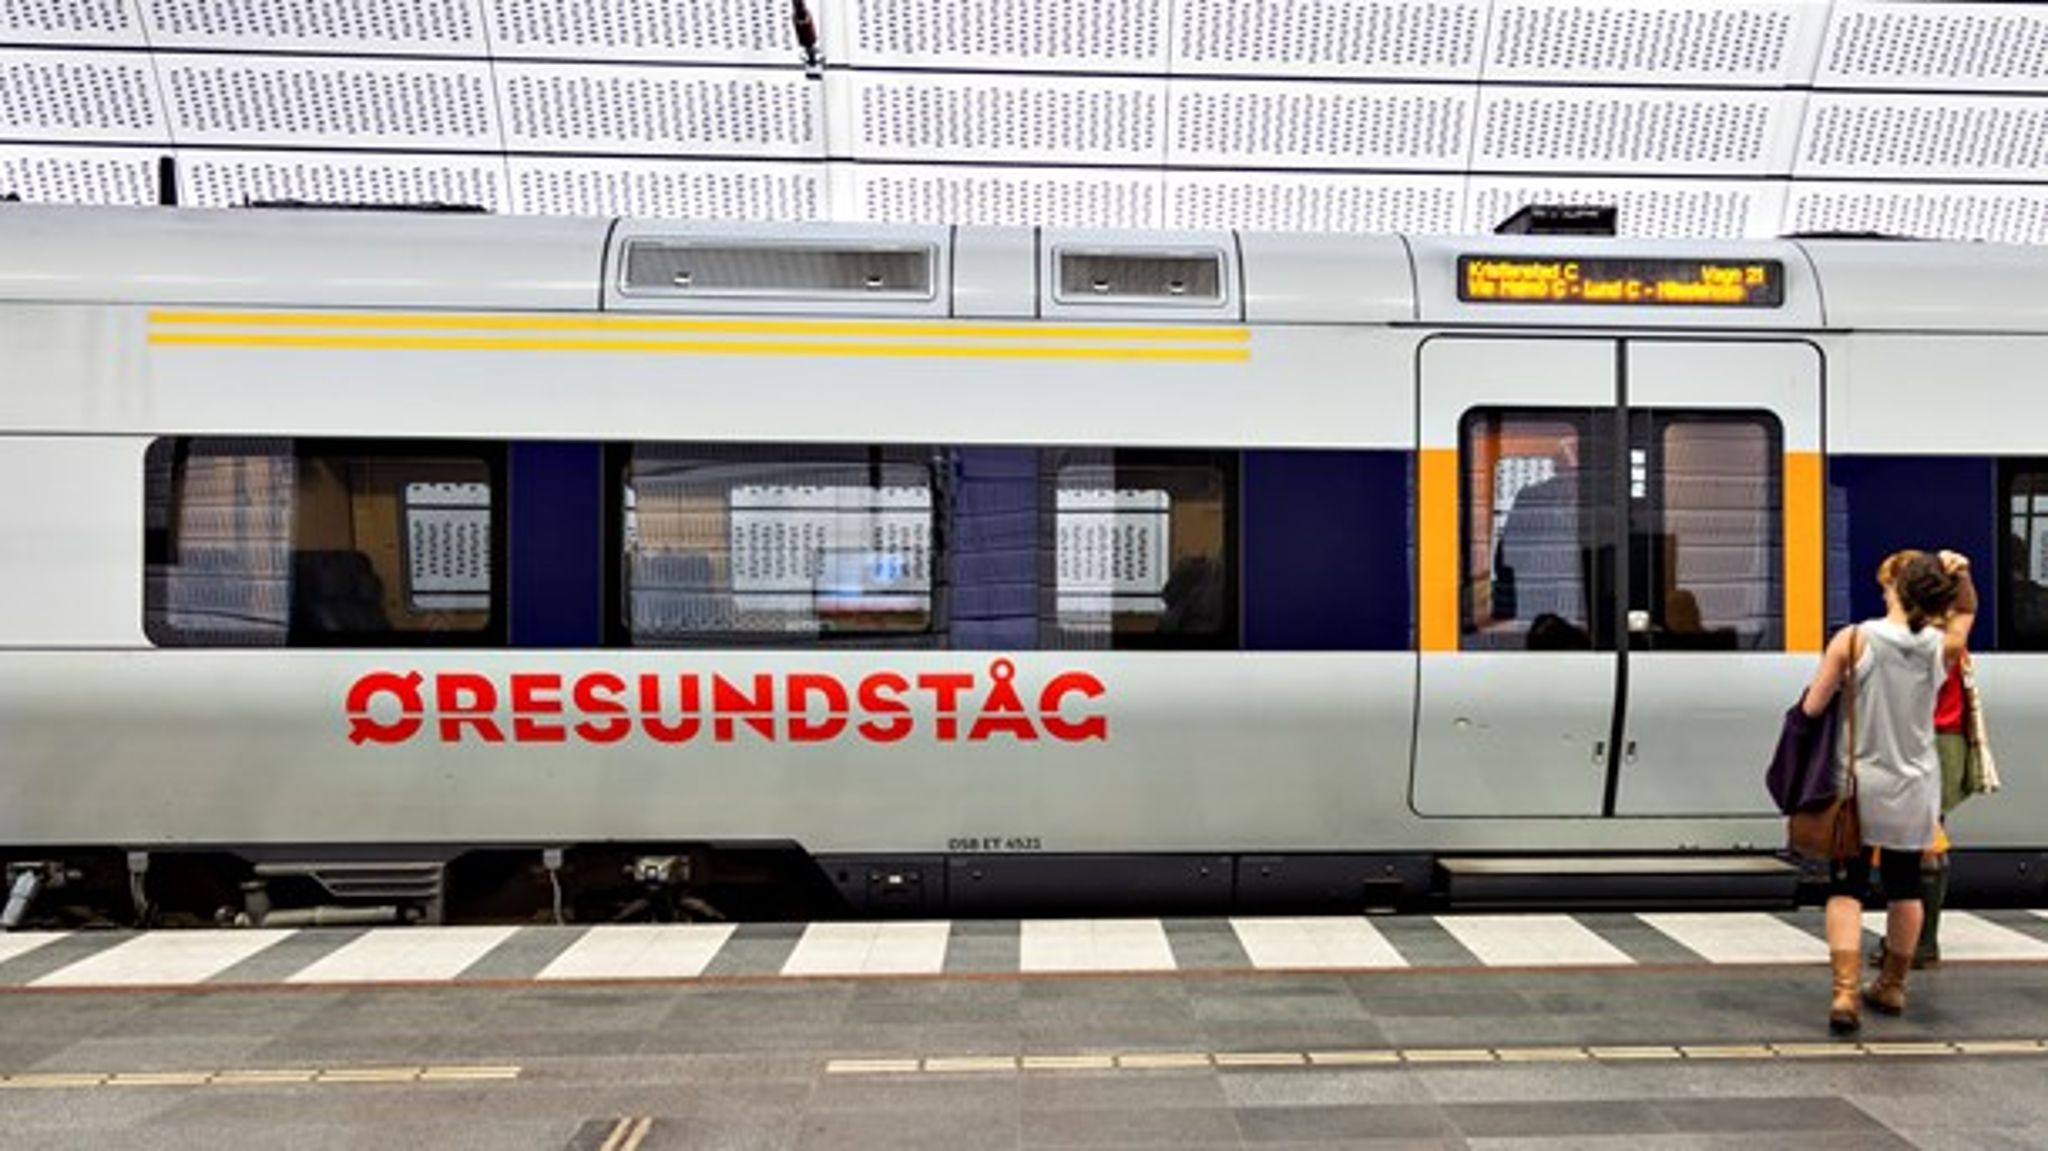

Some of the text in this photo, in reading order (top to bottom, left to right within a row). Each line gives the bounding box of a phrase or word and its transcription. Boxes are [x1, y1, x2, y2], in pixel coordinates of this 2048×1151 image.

[1564, 262, 1579, 280] C
[1625, 281, 1641, 299] C
[345, 657, 1109, 745] ØRESUNDSTÅG
[948, 837, 980, 850] DSB
[983, 837, 1002, 850] ET
